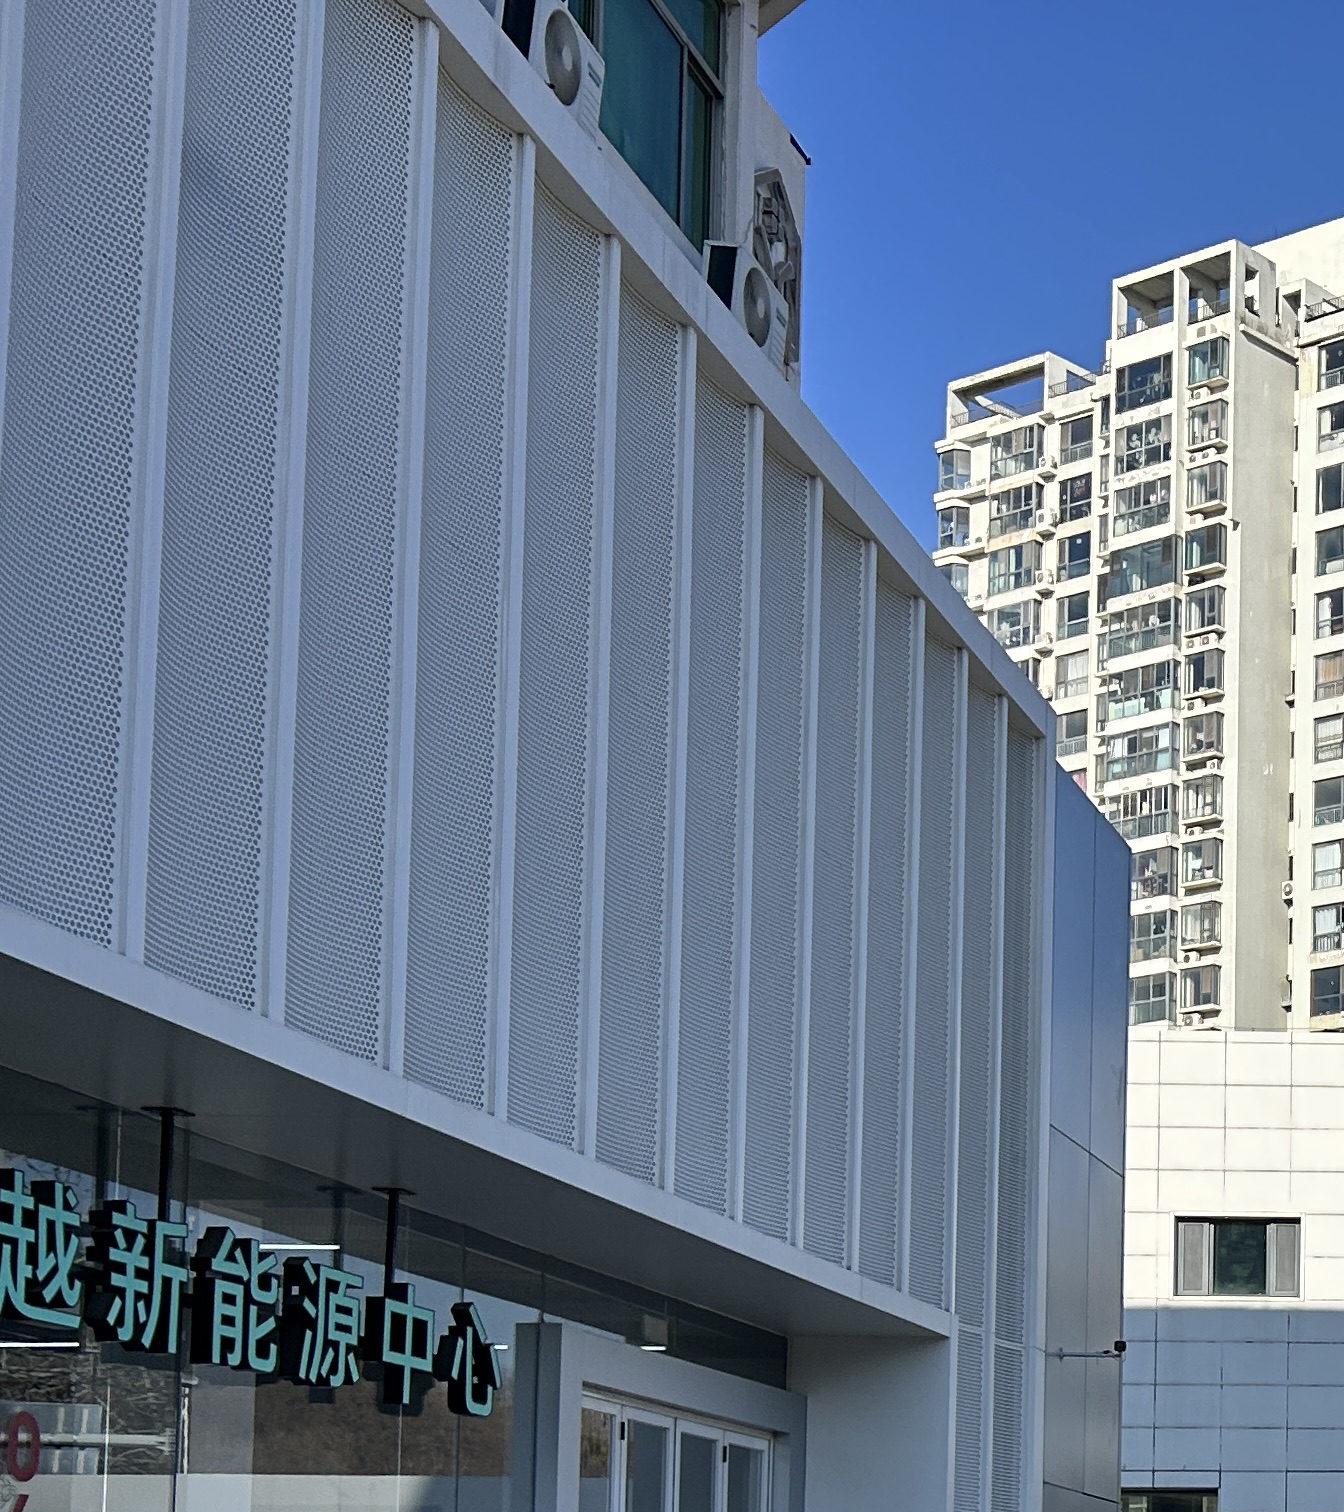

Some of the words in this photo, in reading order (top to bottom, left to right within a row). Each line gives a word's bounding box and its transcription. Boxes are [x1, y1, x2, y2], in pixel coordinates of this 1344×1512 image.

[0, 1170, 501, 1417] 越新能源中心
